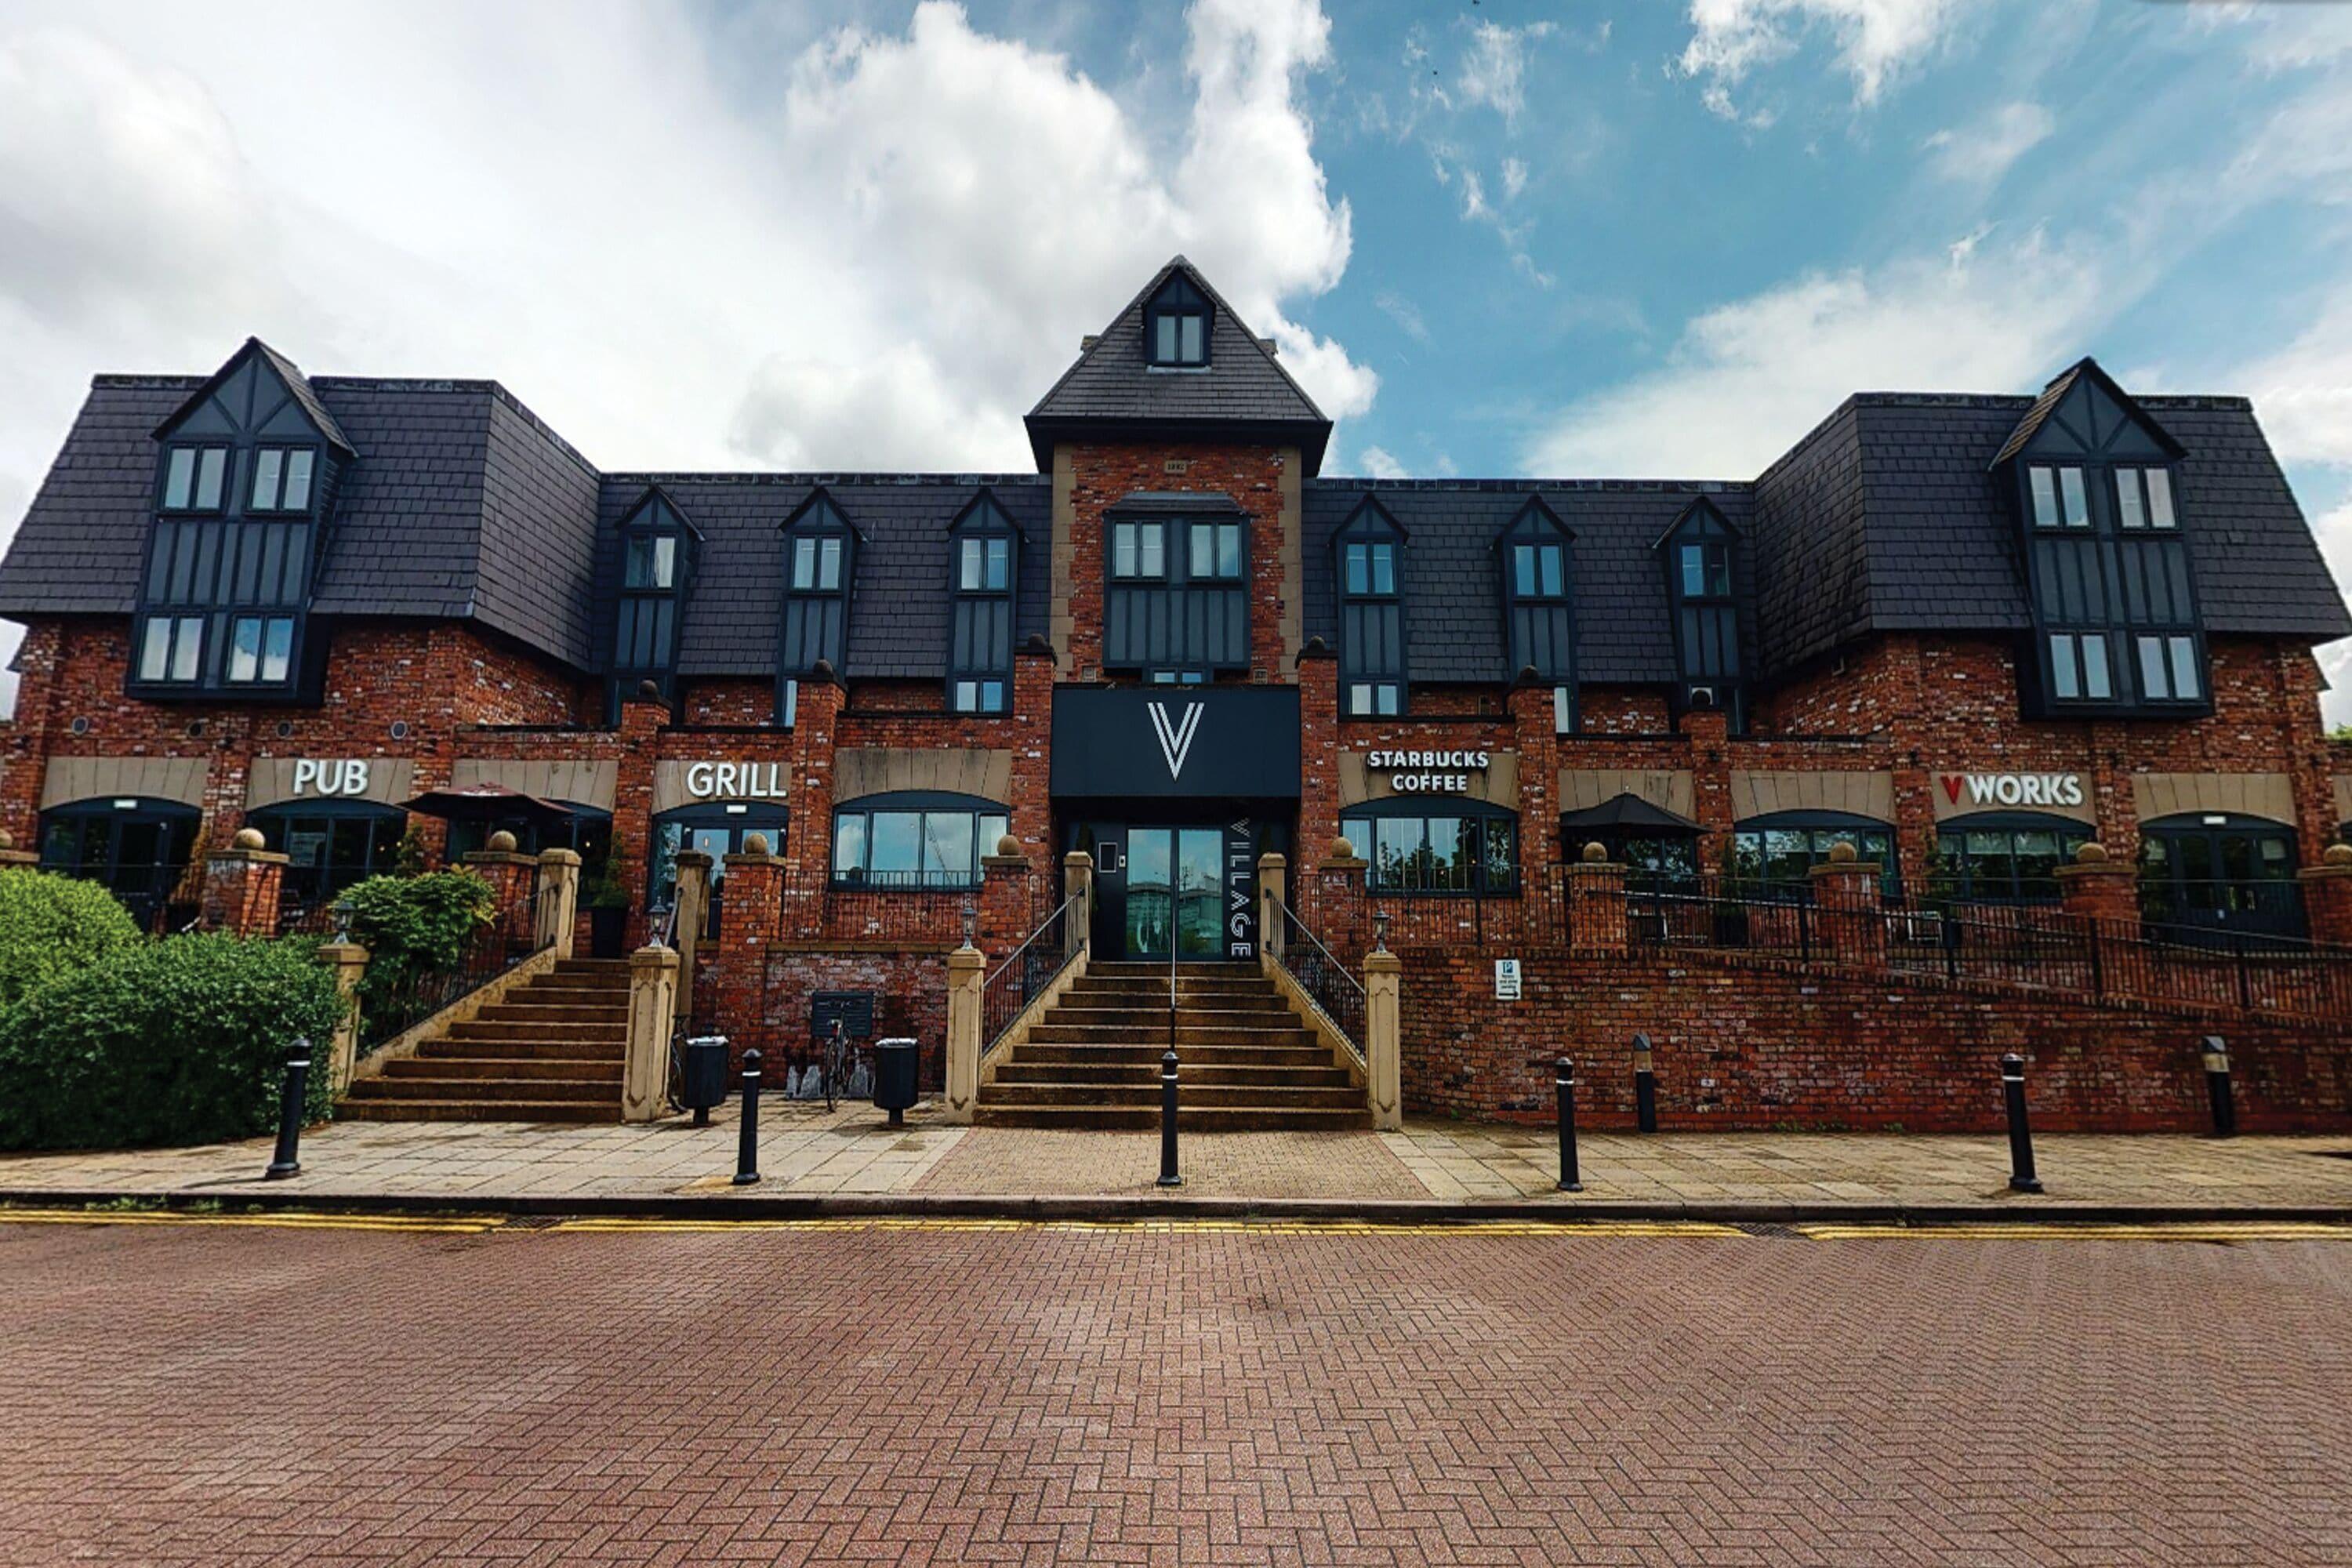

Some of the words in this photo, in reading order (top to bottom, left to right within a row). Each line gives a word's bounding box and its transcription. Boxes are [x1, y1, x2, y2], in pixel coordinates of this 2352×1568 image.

[1147, 702, 1205, 782] V
[1369, 750, 1489, 768] STARBUCKS
[293, 758, 368, 795] PUB
[687, 761, 788, 797] GRILL
[1392, 774, 1468, 792] COFFEE
[1229, 818, 1251, 957] VILLAGE
